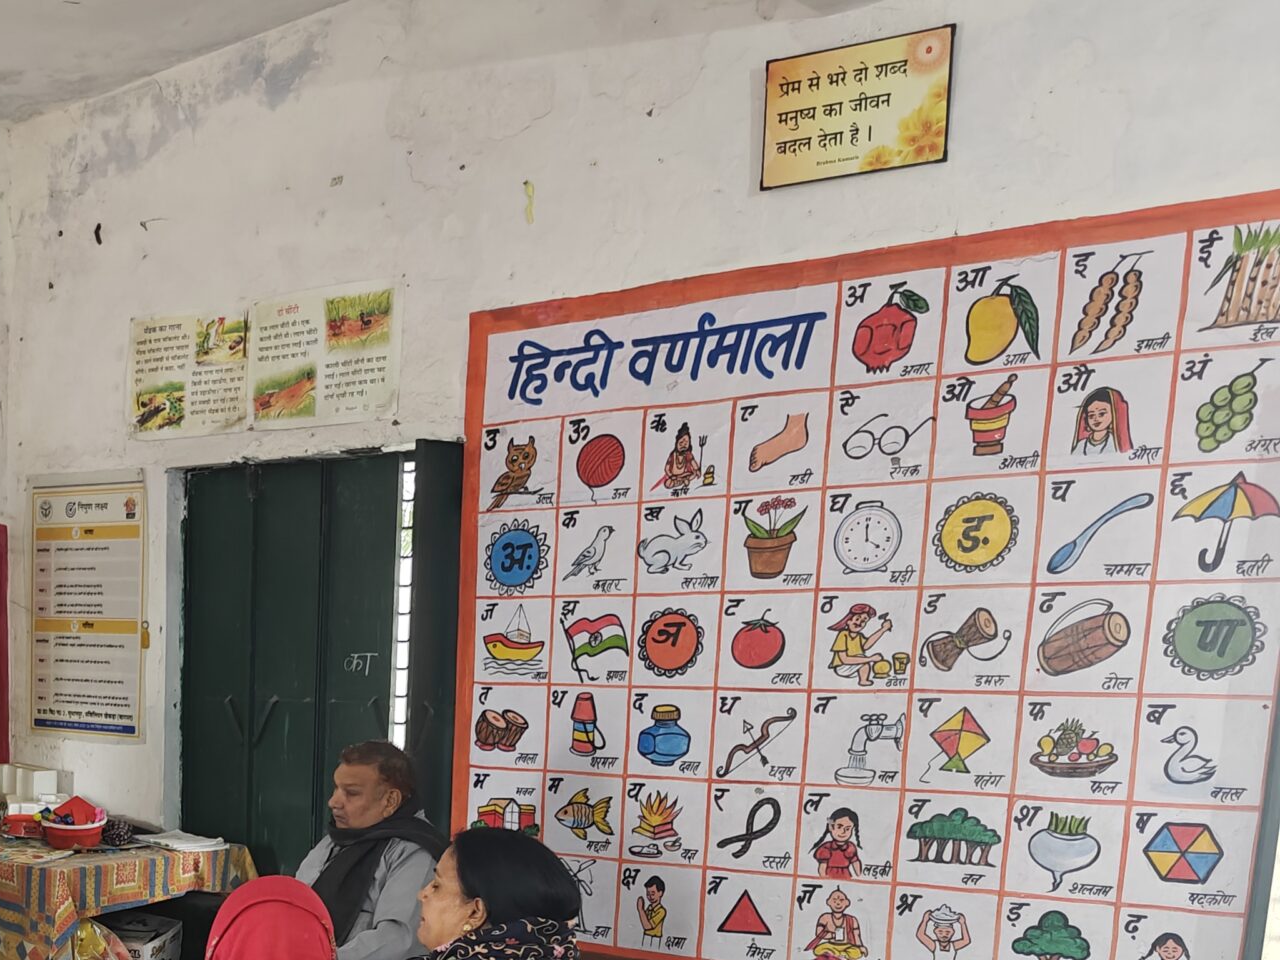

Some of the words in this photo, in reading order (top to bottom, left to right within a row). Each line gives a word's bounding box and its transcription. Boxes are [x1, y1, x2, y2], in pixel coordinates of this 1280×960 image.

[779, 76, 802, 98] प्रेम
[807, 70, 820, 92] से
[827, 65, 847, 87] भरे
[853, 61, 869, 86] दो
[874, 59, 908, 80] शब्द
[777, 106, 816, 131] मनुष्य
[822, 101, 843, 118] का
[849, 92, 891, 112] जीवन
[776, 136, 812, 157] बदल
[818, 128, 844, 151] देता
[1074, 251, 1096, 279] इ
[956, 266, 992, 292] आ
[845, 283, 870, 308] अ
[1134, 336, 1172, 352] इमली
[508, 328, 624, 405] हिन्दी
[628, 312, 827, 386] वर्णमाला
[900, 361, 934, 377] अनार
[1003, 352, 1031, 367] आम
[1180, 353, 1213, 382] अं
[1057, 364, 1092, 394] औ
[942, 377, 975, 404] ओ
[1051, 480, 1075, 501] च
[733, 500, 752, 516] ग
[562, 510, 579, 529] क
[783, 573, 813, 585] गमला
[724, 599, 744, 616] ट
[1195, 618, 1246, 658] ण
[344, 652, 379, 677] का
[771, 672, 803, 686] टमाटर
[1101, 673, 1133, 692] ढोल
[814, 695, 837, 715] न
[917, 697, 941, 718] प
[1028, 701, 1056, 722] फ
[1145, 703, 1175, 726] ब
[548, 776, 564, 795] म
[875, 768, 898, 785] नल
[1090, 778, 1122, 796] फल
[713, 787, 730, 812] र
[803, 792, 830, 813] ल
[1014, 804, 1043, 831] श
[961, 873, 985, 887] वन
